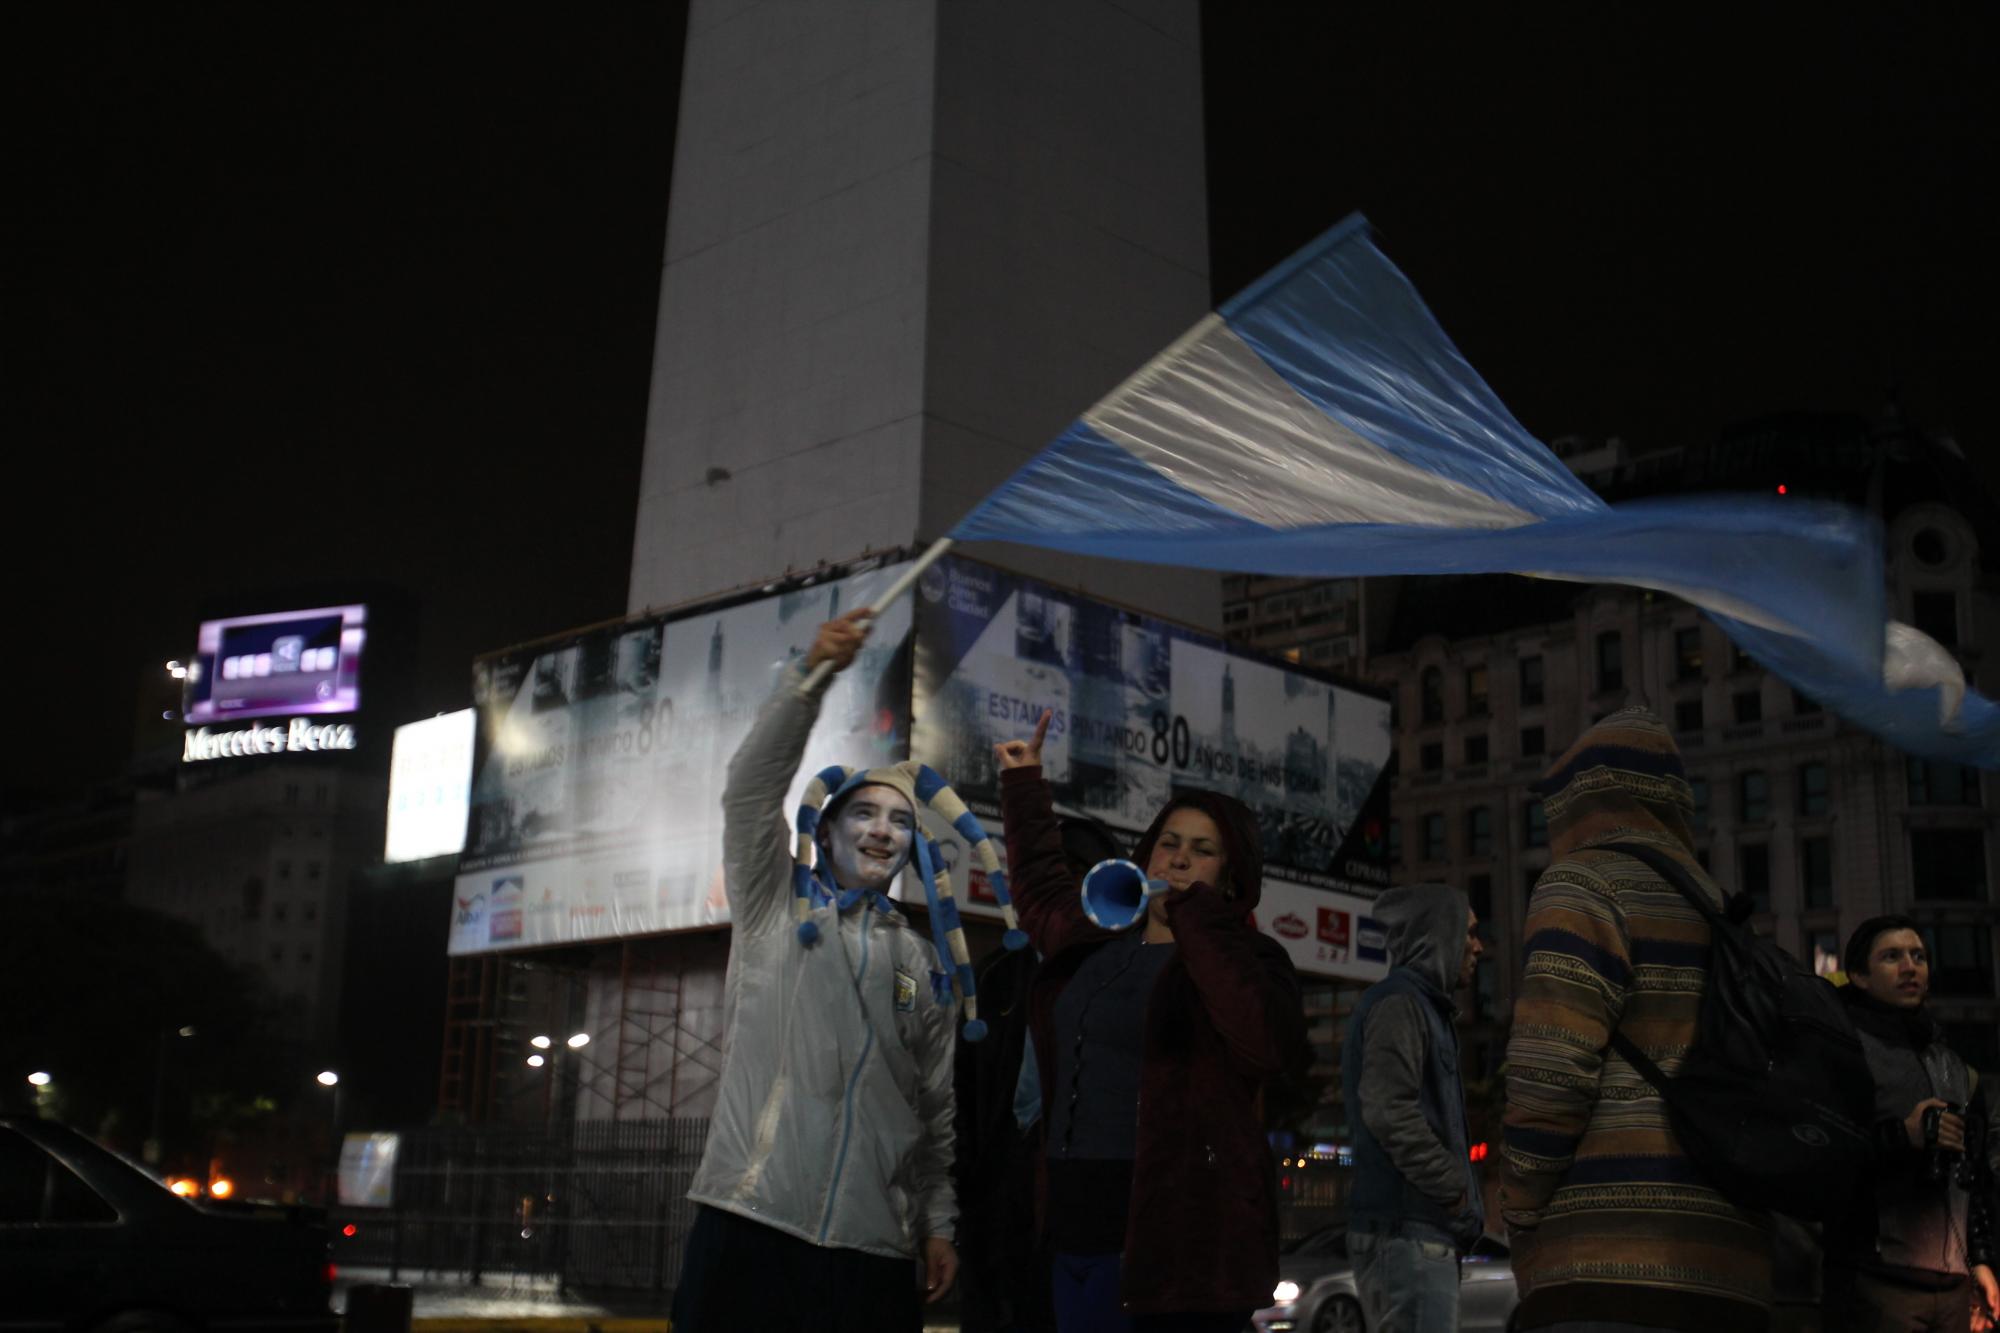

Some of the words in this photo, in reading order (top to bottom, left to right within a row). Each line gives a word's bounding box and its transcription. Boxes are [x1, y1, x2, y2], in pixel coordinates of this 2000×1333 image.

[637, 697, 673, 756] 80
[1071, 714, 1146, 754] PINTANDO
[1152, 710, 1190, 769] 80
[1237, 757, 1255, 782] DE
[1258, 765, 1321, 793] HISTORIA
